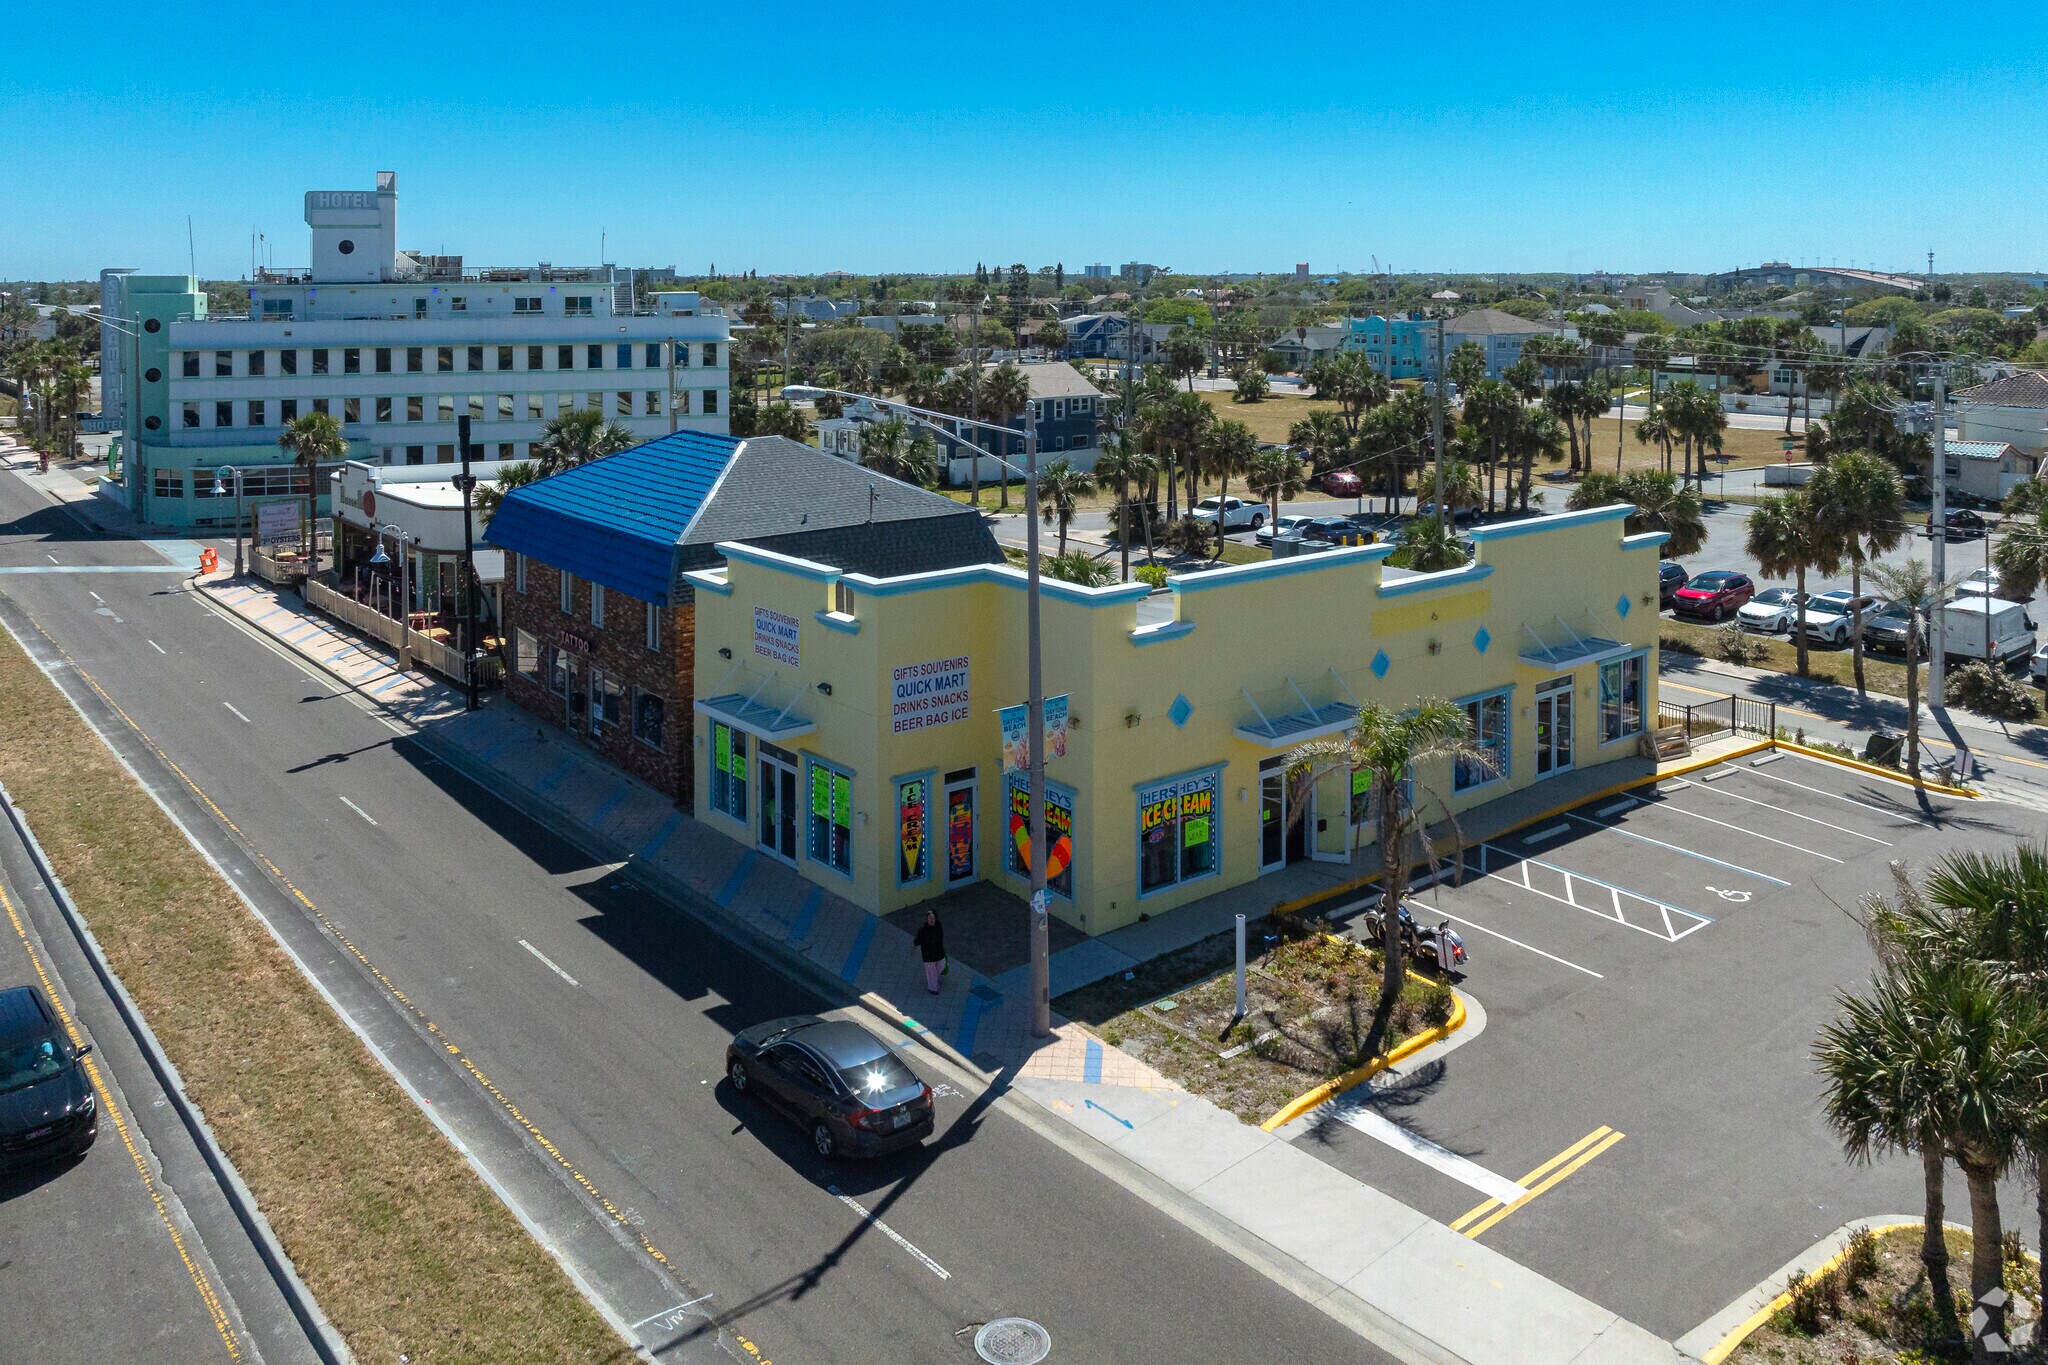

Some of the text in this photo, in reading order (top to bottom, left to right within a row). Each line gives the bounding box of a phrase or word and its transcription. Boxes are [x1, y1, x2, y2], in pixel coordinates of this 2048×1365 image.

[319, 192, 372, 208] HOTEL
[90, 420, 124, 430] HOTEL
[270, 535, 301, 544] OYSTERS
[754, 606, 800, 629] GIFTS SOUVENIRS
[560, 630, 589, 652] TATTOO
[756, 618, 798, 641] QUICK MART
[754, 631, 800, 655] DRINKS SNACKS
[754, 644, 800, 668] BEER BAG ICE
[893, 656, 969, 681] GIFTS SOUVENIRS
[896, 672, 966, 698] QUICK MART
[893, 690, 969, 716] DRINKS SNACKS
[1045, 706, 1067, 715] DAYTONA
[894, 706, 969, 733] BEER BAG ICE
[1003, 716, 1025, 726] DAYTONA
[1003, 722, 1027, 733] BEACH
[1046, 711, 1068, 722] BEACH
[1011, 786, 1030, 818] ICE
[1142, 776, 1211, 805] HERSHEY'S
[905, 787, 919, 852] ICE CREAM
[1141, 790, 1212, 832] ICE CREAM
